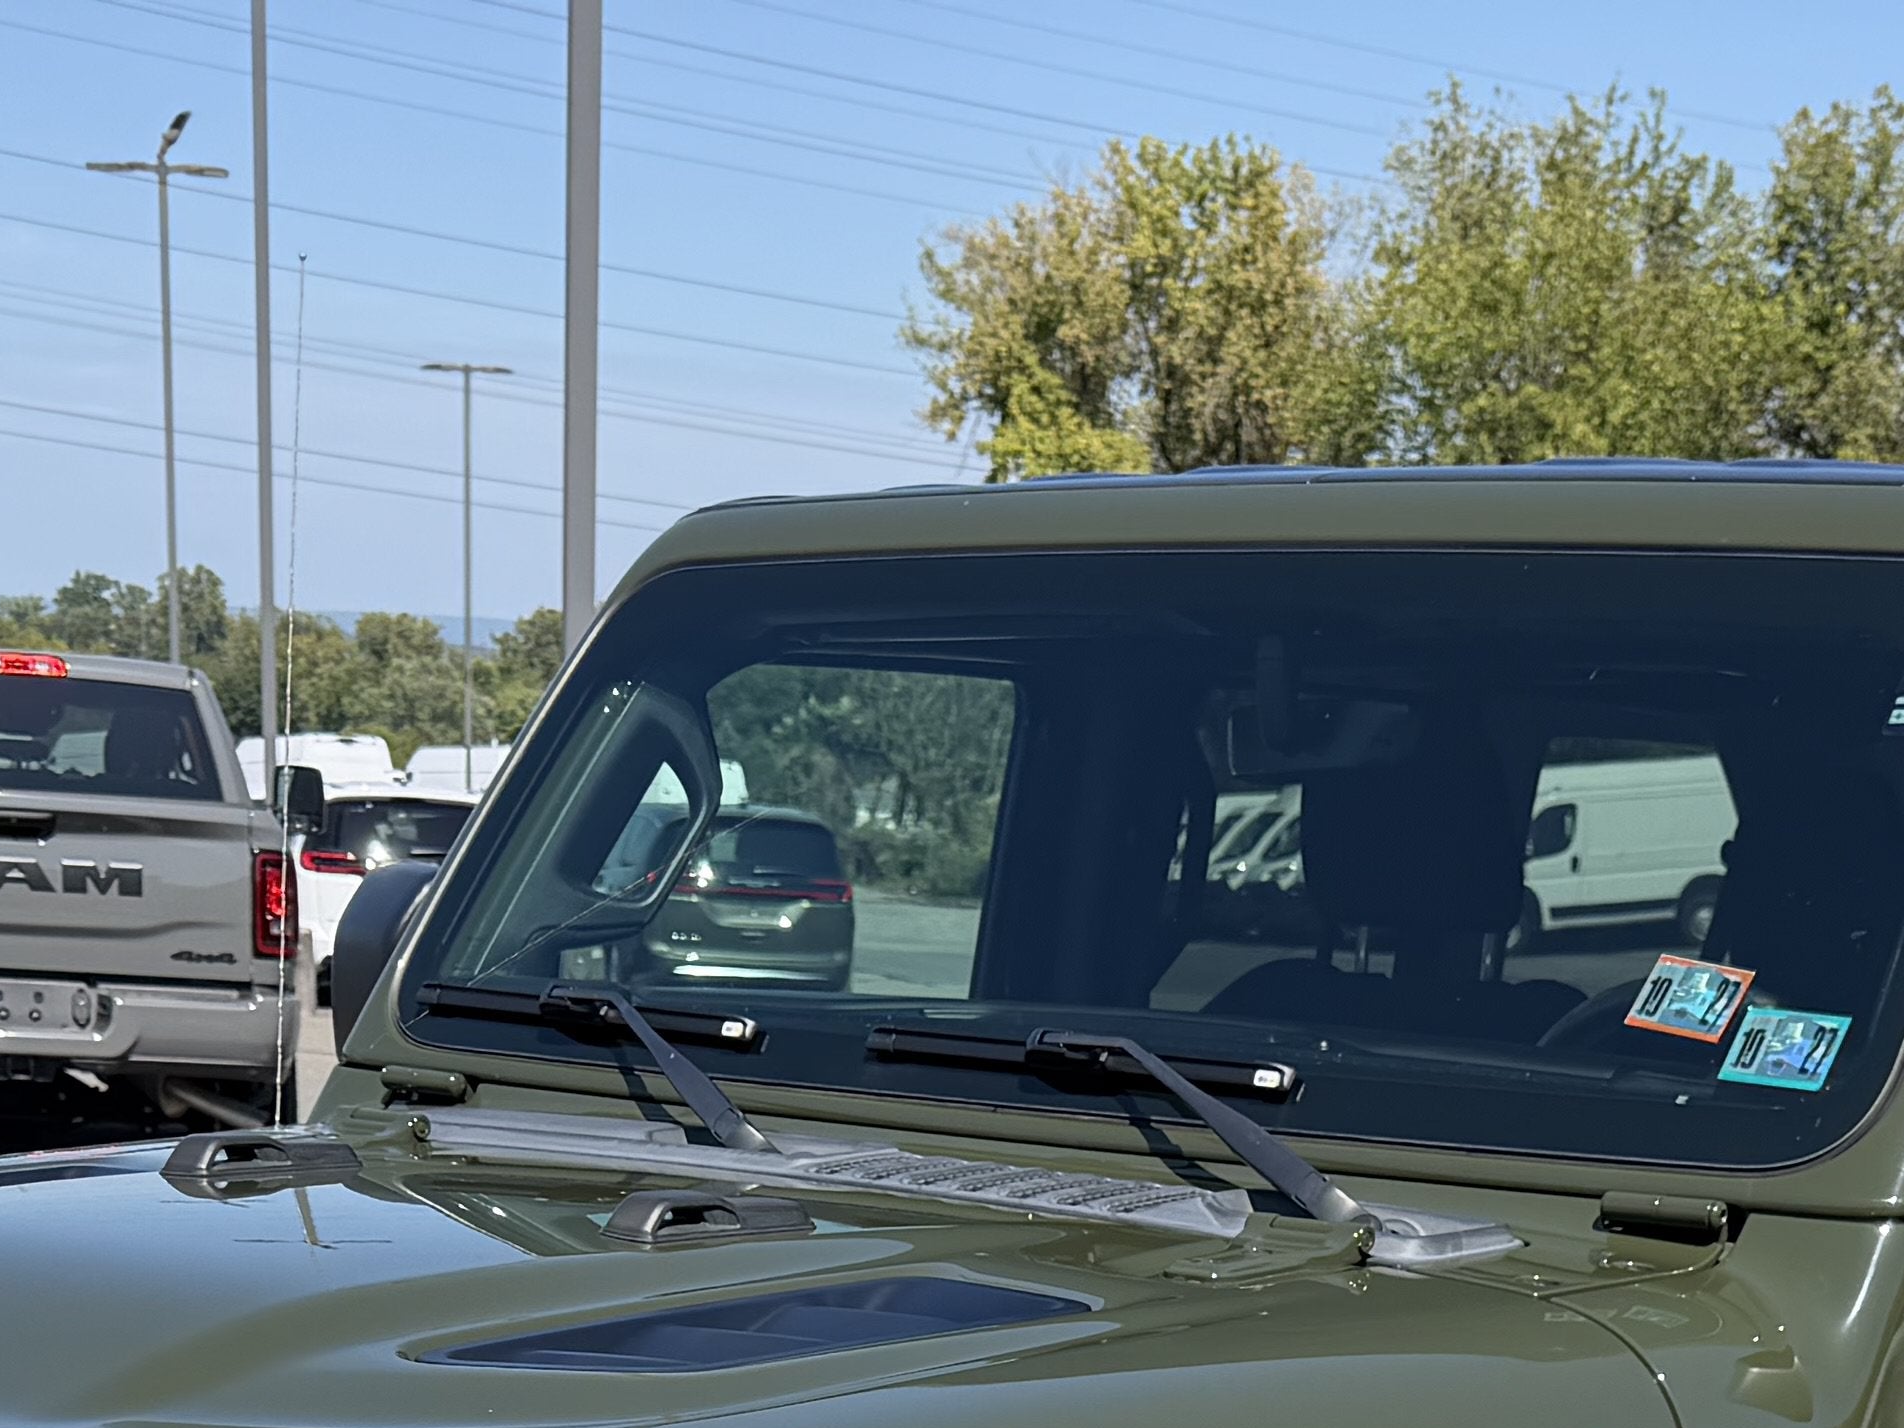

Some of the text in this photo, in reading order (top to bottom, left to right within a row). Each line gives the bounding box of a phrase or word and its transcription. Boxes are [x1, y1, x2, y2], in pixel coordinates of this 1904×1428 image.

[170, 950, 238, 965] 4x4
[1698, 977, 1742, 1033] 27
[1797, 1026, 1839, 1076] 27
